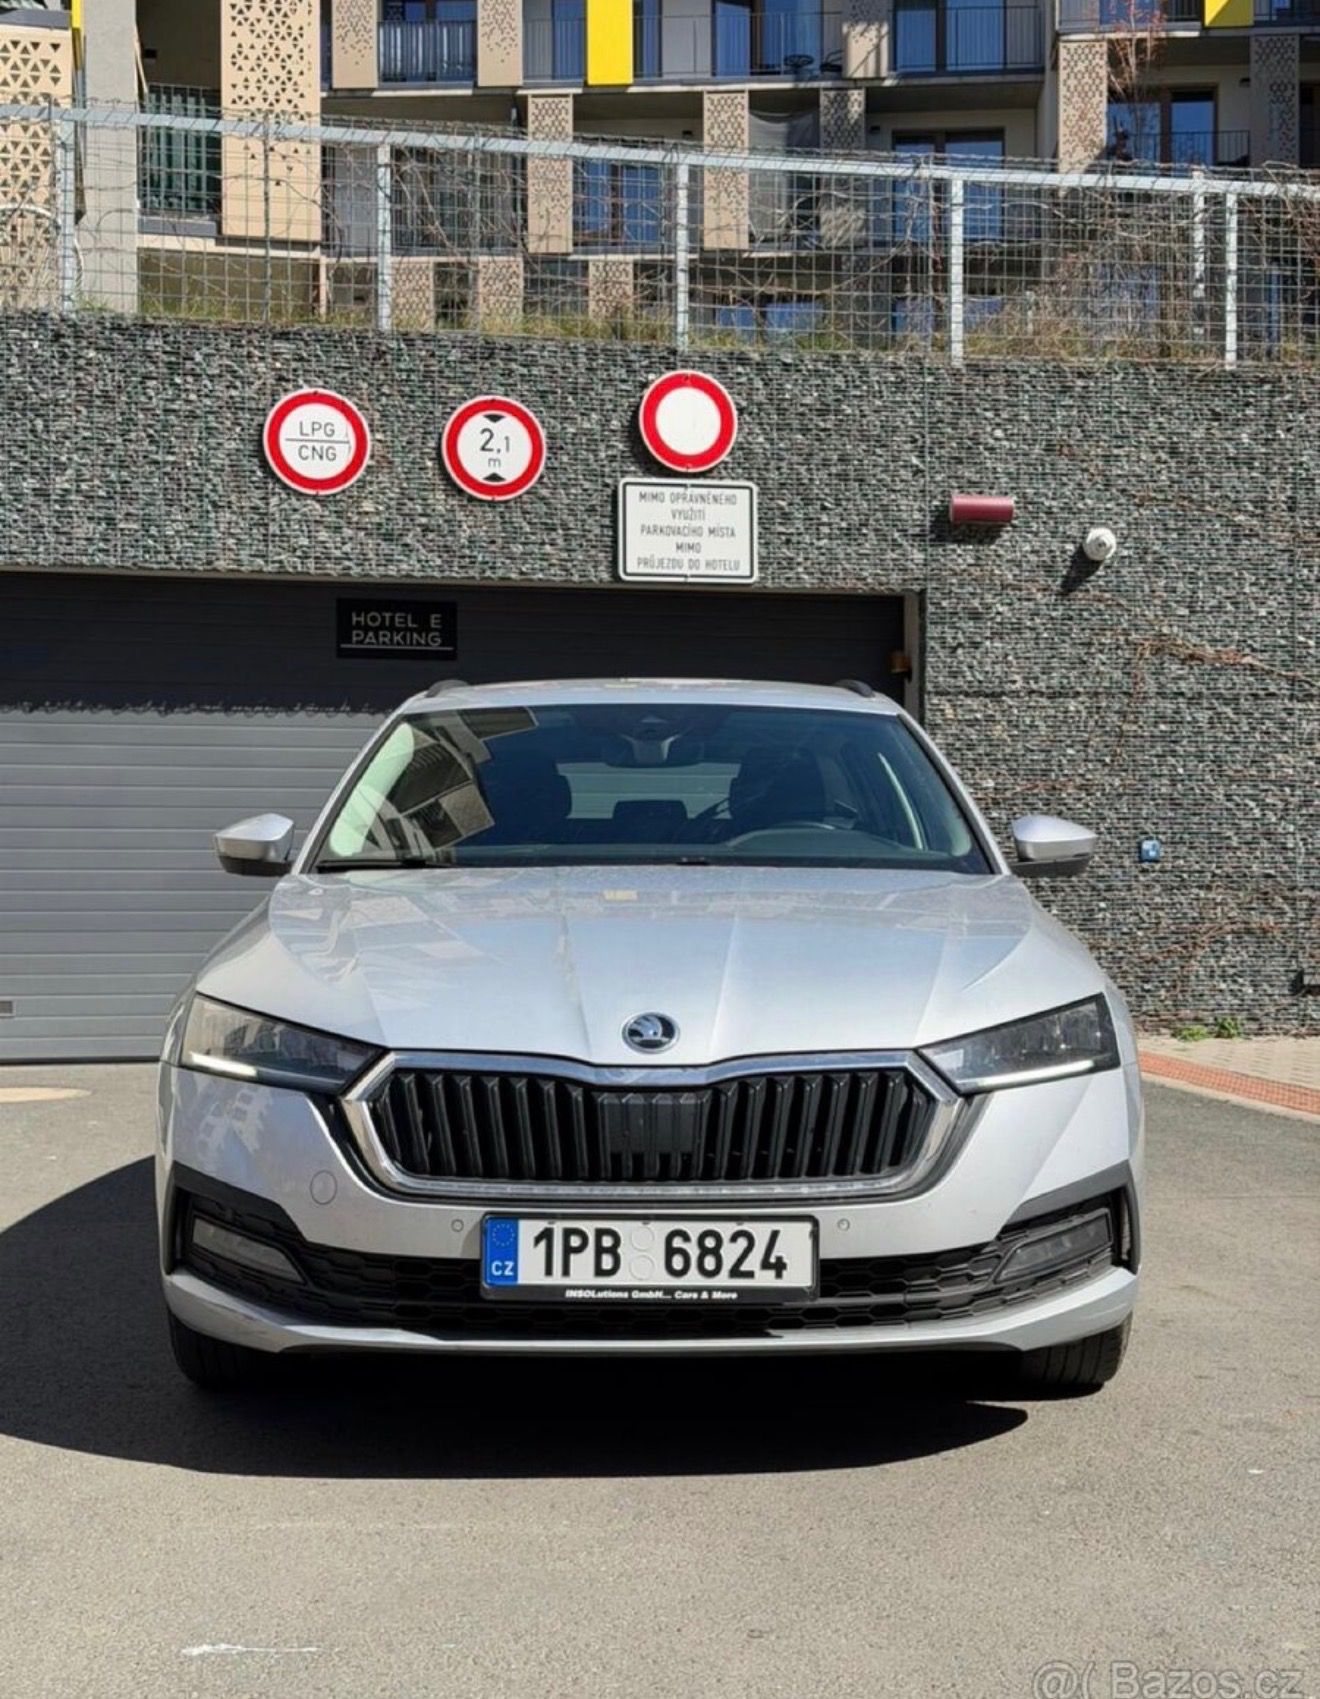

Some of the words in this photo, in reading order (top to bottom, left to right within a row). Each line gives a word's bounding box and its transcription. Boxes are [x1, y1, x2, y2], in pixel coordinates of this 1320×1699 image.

[299, 421, 335, 437] LPG
[297, 445, 337, 462] CNG
[488, 458, 501, 468] m
[639, 492, 665, 503] MIMO
[640, 523, 704, 538] PARKOVACÍHO
[708, 524, 736, 538] MÍSTA
[675, 542, 702, 554] MIMO
[688, 558, 701, 571] DO
[705, 559, 741, 571] HOTELU
[351, 611, 418, 628] HOTEL
[430, 613, 442, 629] E
[351, 630, 442, 647] PARKING
[533, 1227, 622, 1278] 1PB
[664, 1229, 788, 1279] 6824
[491, 1261, 514, 1276] CZ
[674, 1290, 698, 1299] Cars
[701, 1291, 709, 1299] &
[712, 1291, 738, 1300] More
